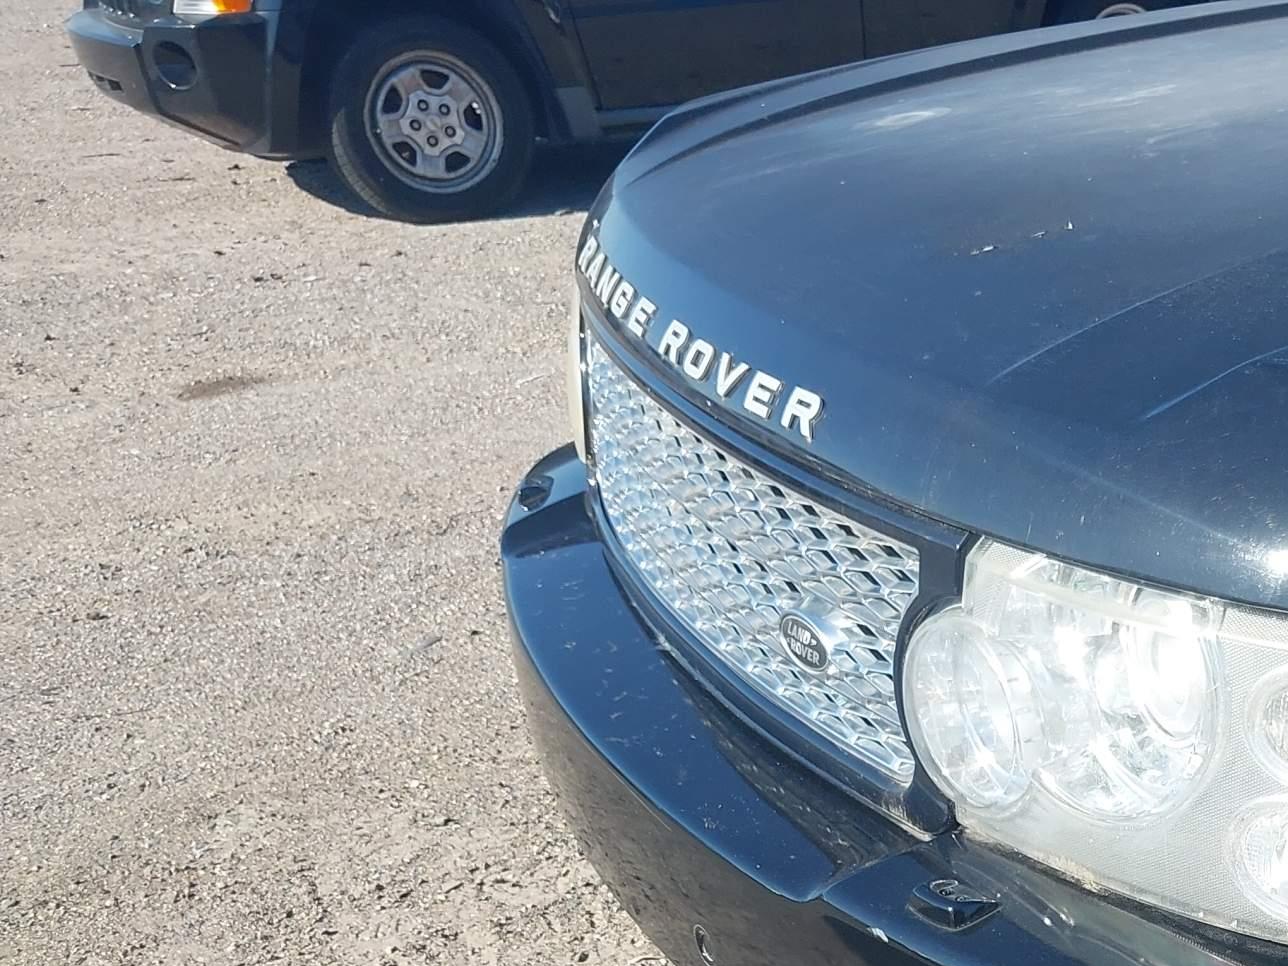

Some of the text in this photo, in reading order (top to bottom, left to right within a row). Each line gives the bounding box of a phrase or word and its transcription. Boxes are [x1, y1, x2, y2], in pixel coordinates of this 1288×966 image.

[578, 235, 824, 444] RANGE ROVER
[787, 620, 812, 646] LAND
[789, 636, 821, 666] ROVER
